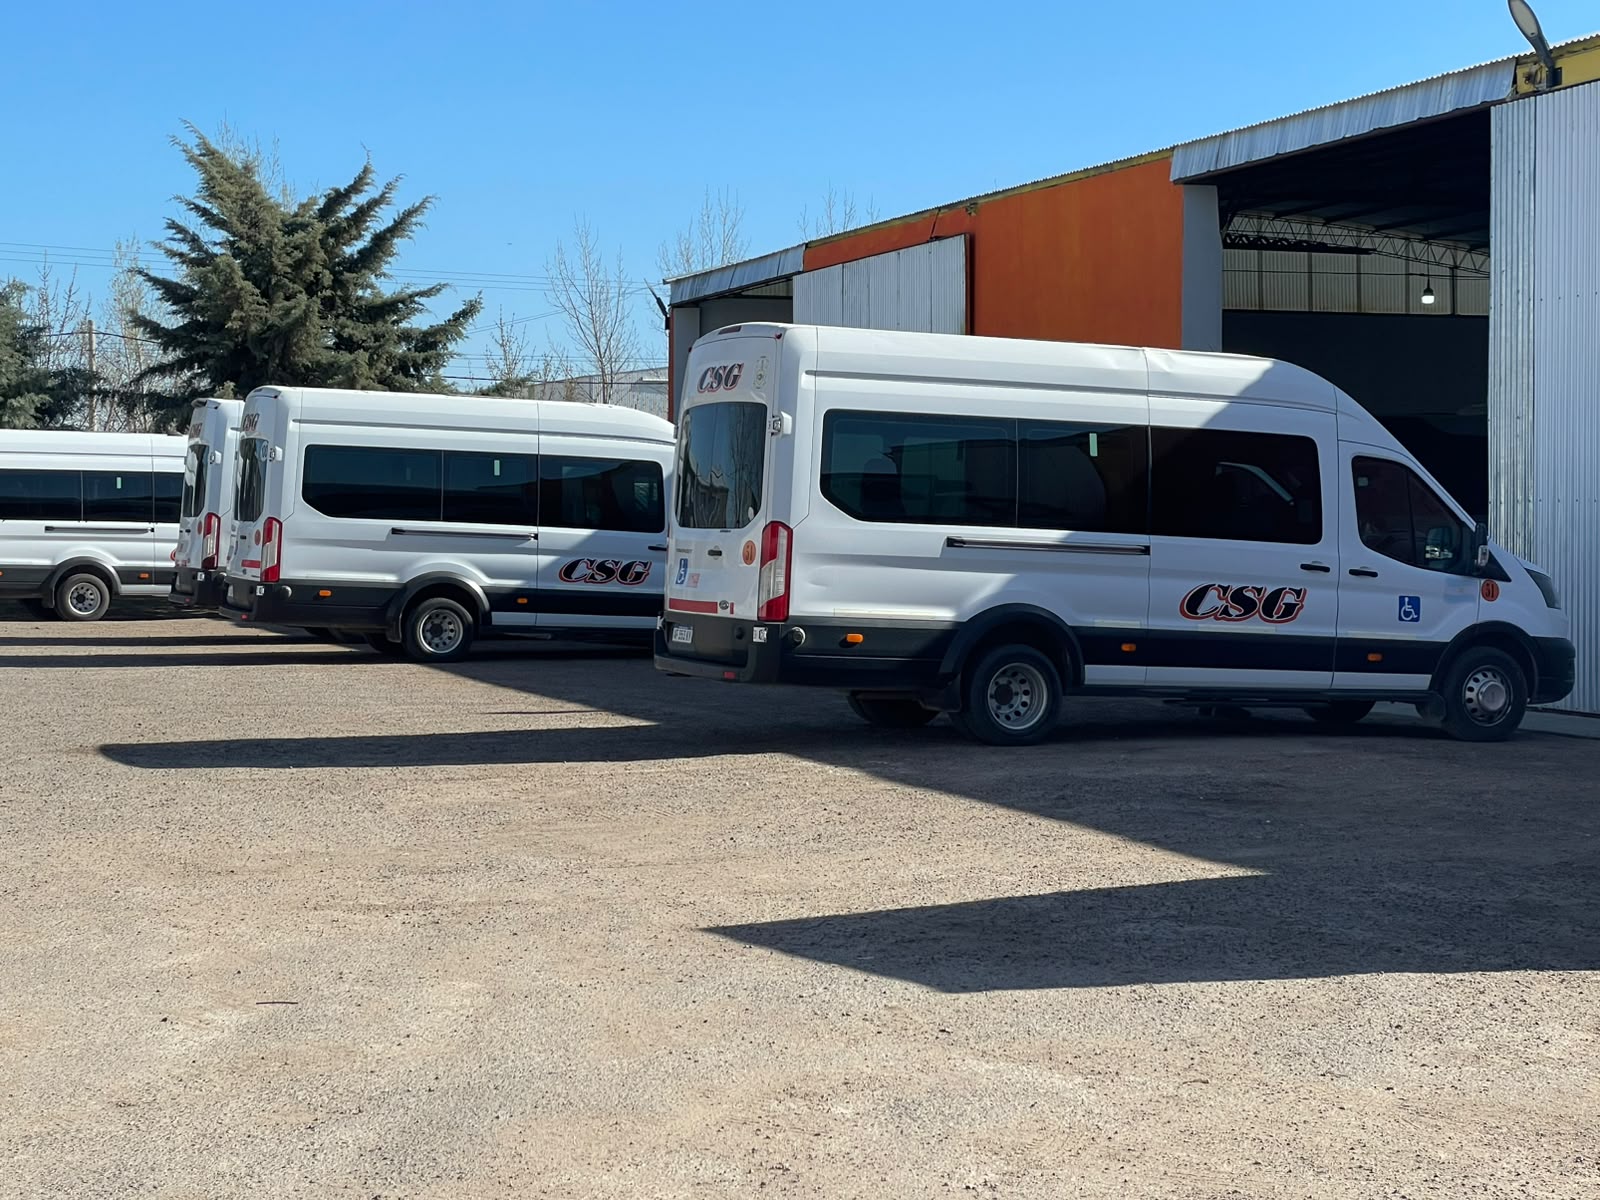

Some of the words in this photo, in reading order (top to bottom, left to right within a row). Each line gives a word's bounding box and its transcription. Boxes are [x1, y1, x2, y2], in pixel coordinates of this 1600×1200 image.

[697, 362, 744, 393] CSG
[558, 557, 653, 586] CSG
[1179, 583, 1308, 625] CSG
